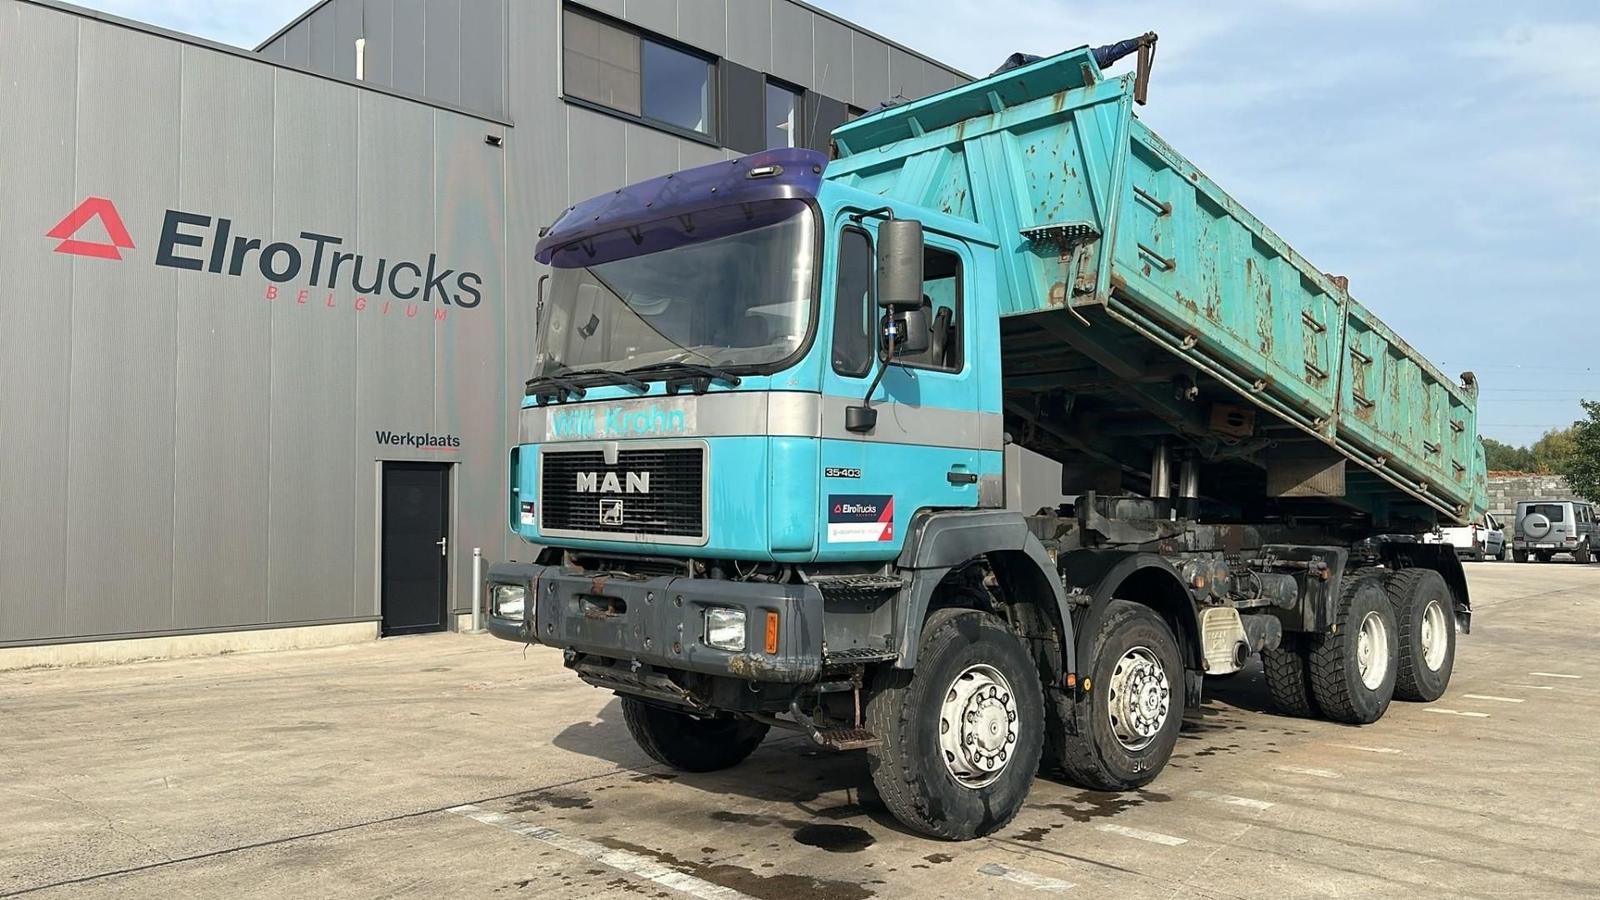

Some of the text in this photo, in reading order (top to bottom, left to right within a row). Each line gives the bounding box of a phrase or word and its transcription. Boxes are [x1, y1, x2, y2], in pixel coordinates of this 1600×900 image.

[155, 209, 483, 309] ElroTrucks
[265, 285, 448, 321] BELGIUM
[604, 405, 685, 434] Krohn
[375, 430, 460, 448] Werkplaats
[576, 471, 650, 494] MAN
[842, 503, 877, 513] ElroTrucks
